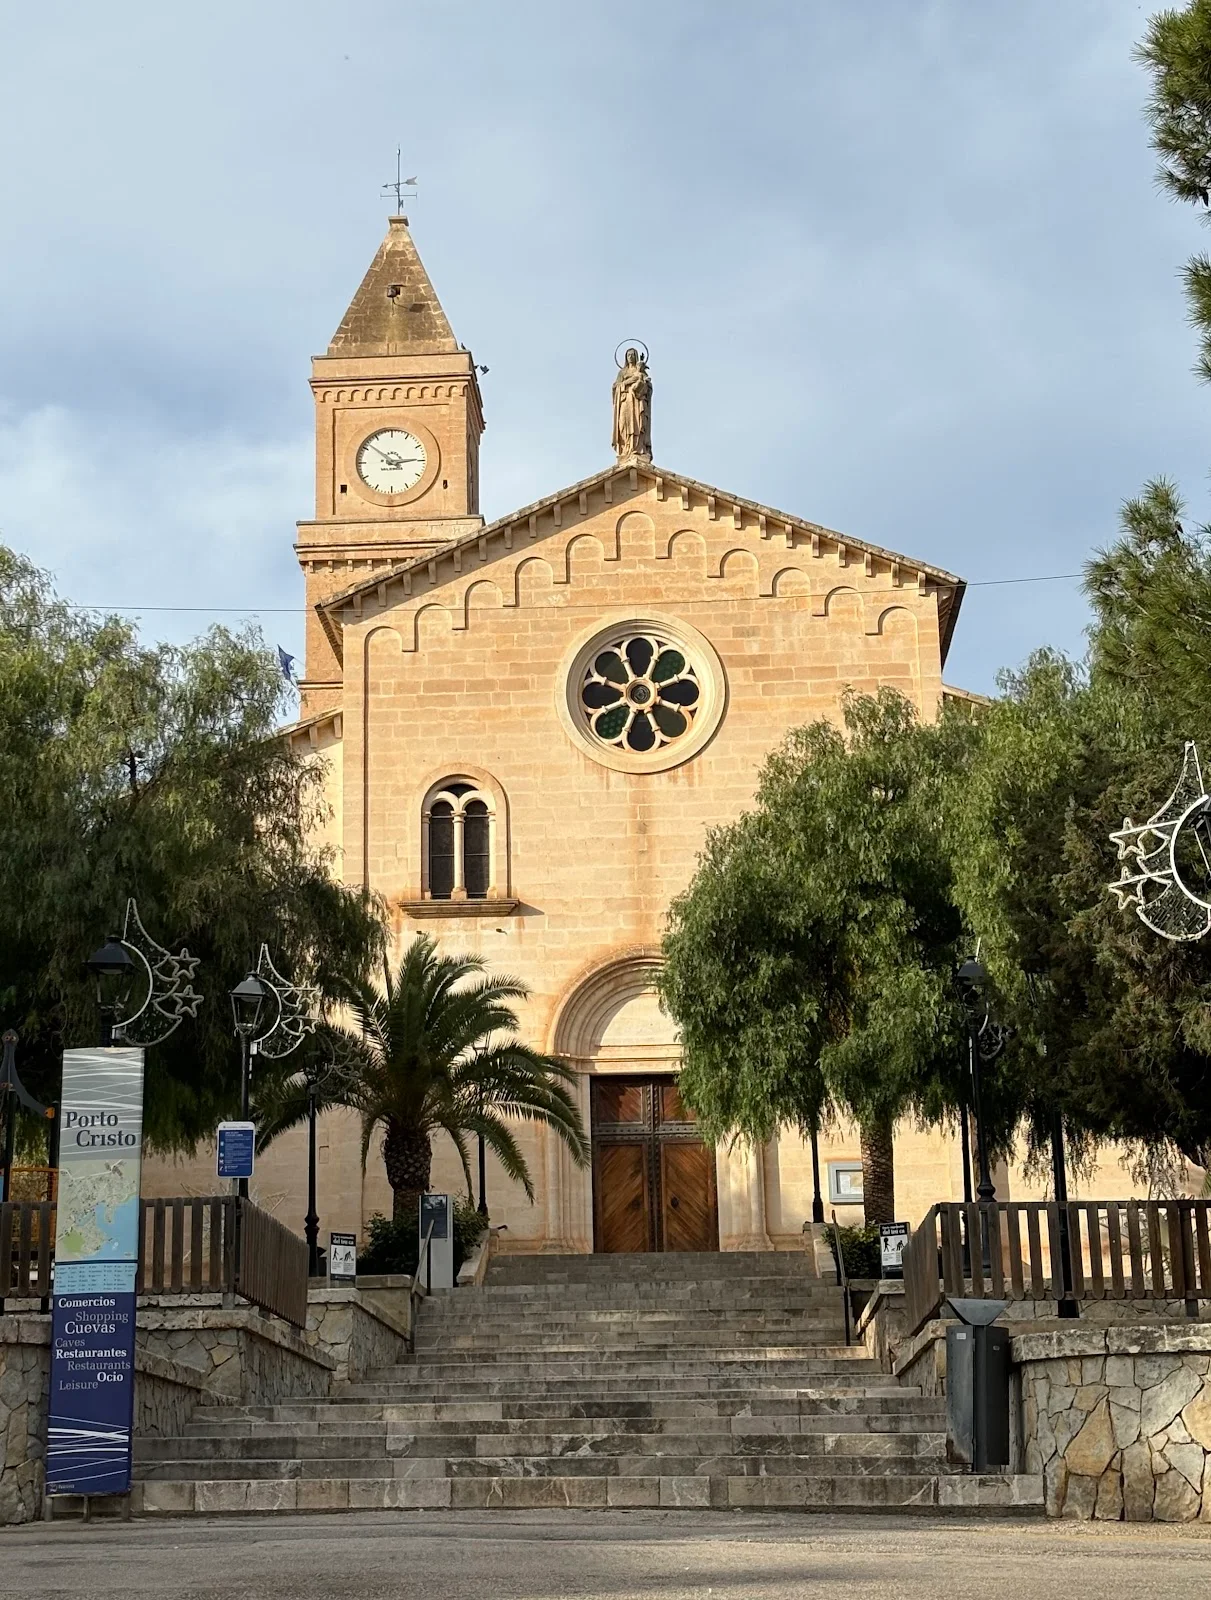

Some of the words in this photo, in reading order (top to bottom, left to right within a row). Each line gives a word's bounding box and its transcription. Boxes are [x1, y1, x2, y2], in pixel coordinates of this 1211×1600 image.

[65, 1111, 118, 1128] Porto
[76, 1130, 136, 1147] Cristo
[58, 1296, 116, 1308] Comercios
[75, 1310, 129, 1323] Shopping
[65, 1321, 116, 1334] Cuevas
[55, 1338, 86, 1348] Caves
[55, 1348, 127, 1359] Restaurantes
[67, 1360, 131, 1371] Restaurants
[97, 1371, 124, 1382] Ocio
[59, 1380, 99, 1391] Leisure
